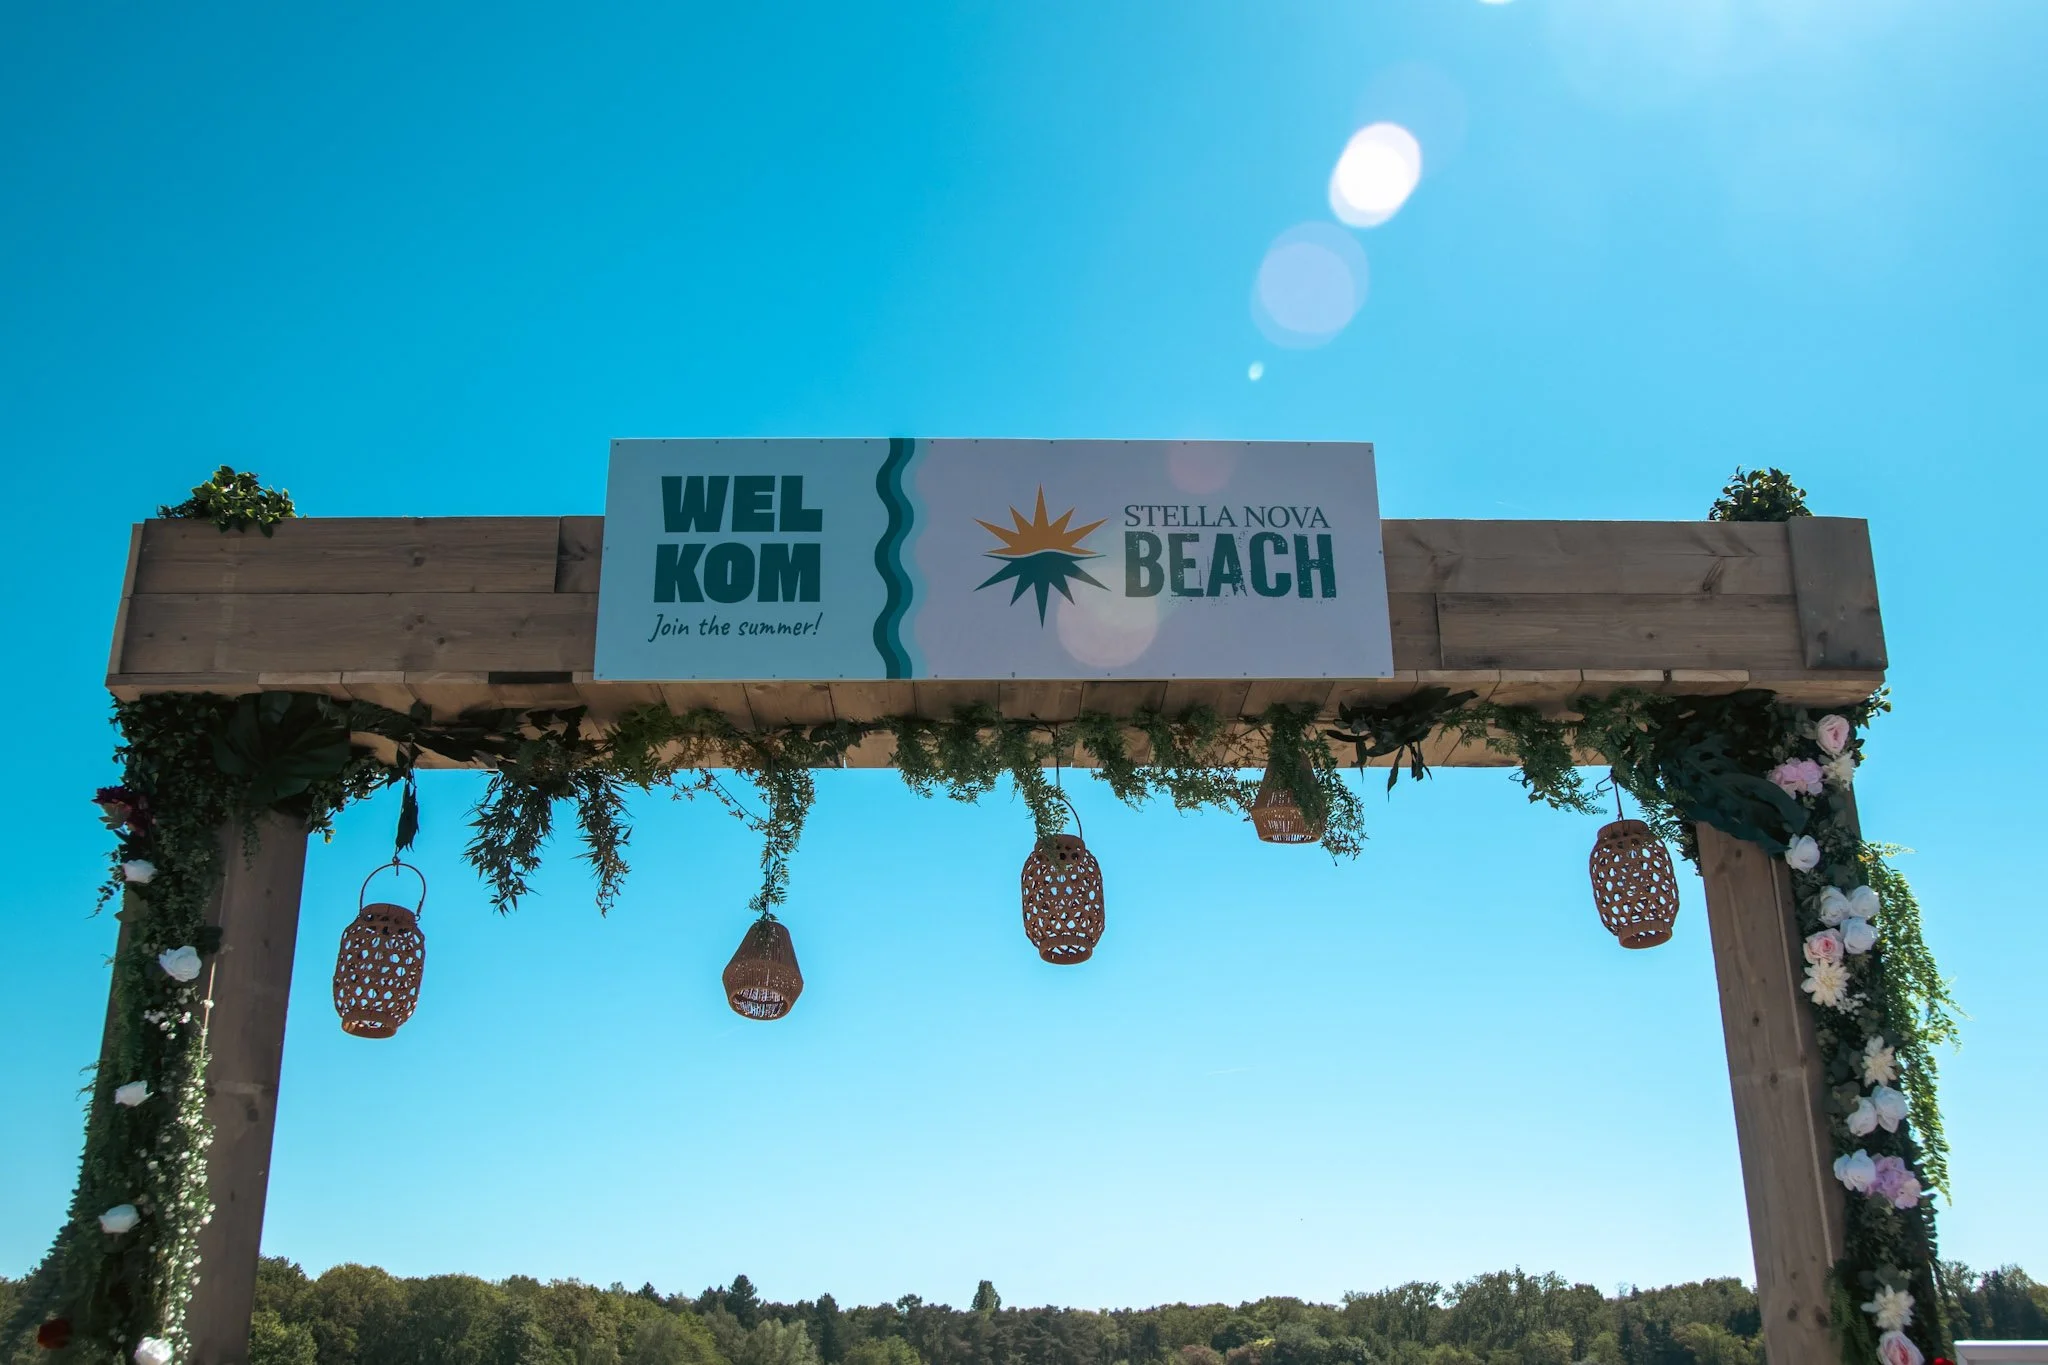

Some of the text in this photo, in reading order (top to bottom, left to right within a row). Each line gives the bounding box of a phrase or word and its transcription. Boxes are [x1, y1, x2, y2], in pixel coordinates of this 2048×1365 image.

[661, 475, 823, 533] WEL
[1124, 504, 1332, 529] STELLA NOVA
[653, 542, 821, 604] KOM
[1124, 530, 1337, 599] BEACH
[647, 611, 824, 643] Join the summer!
